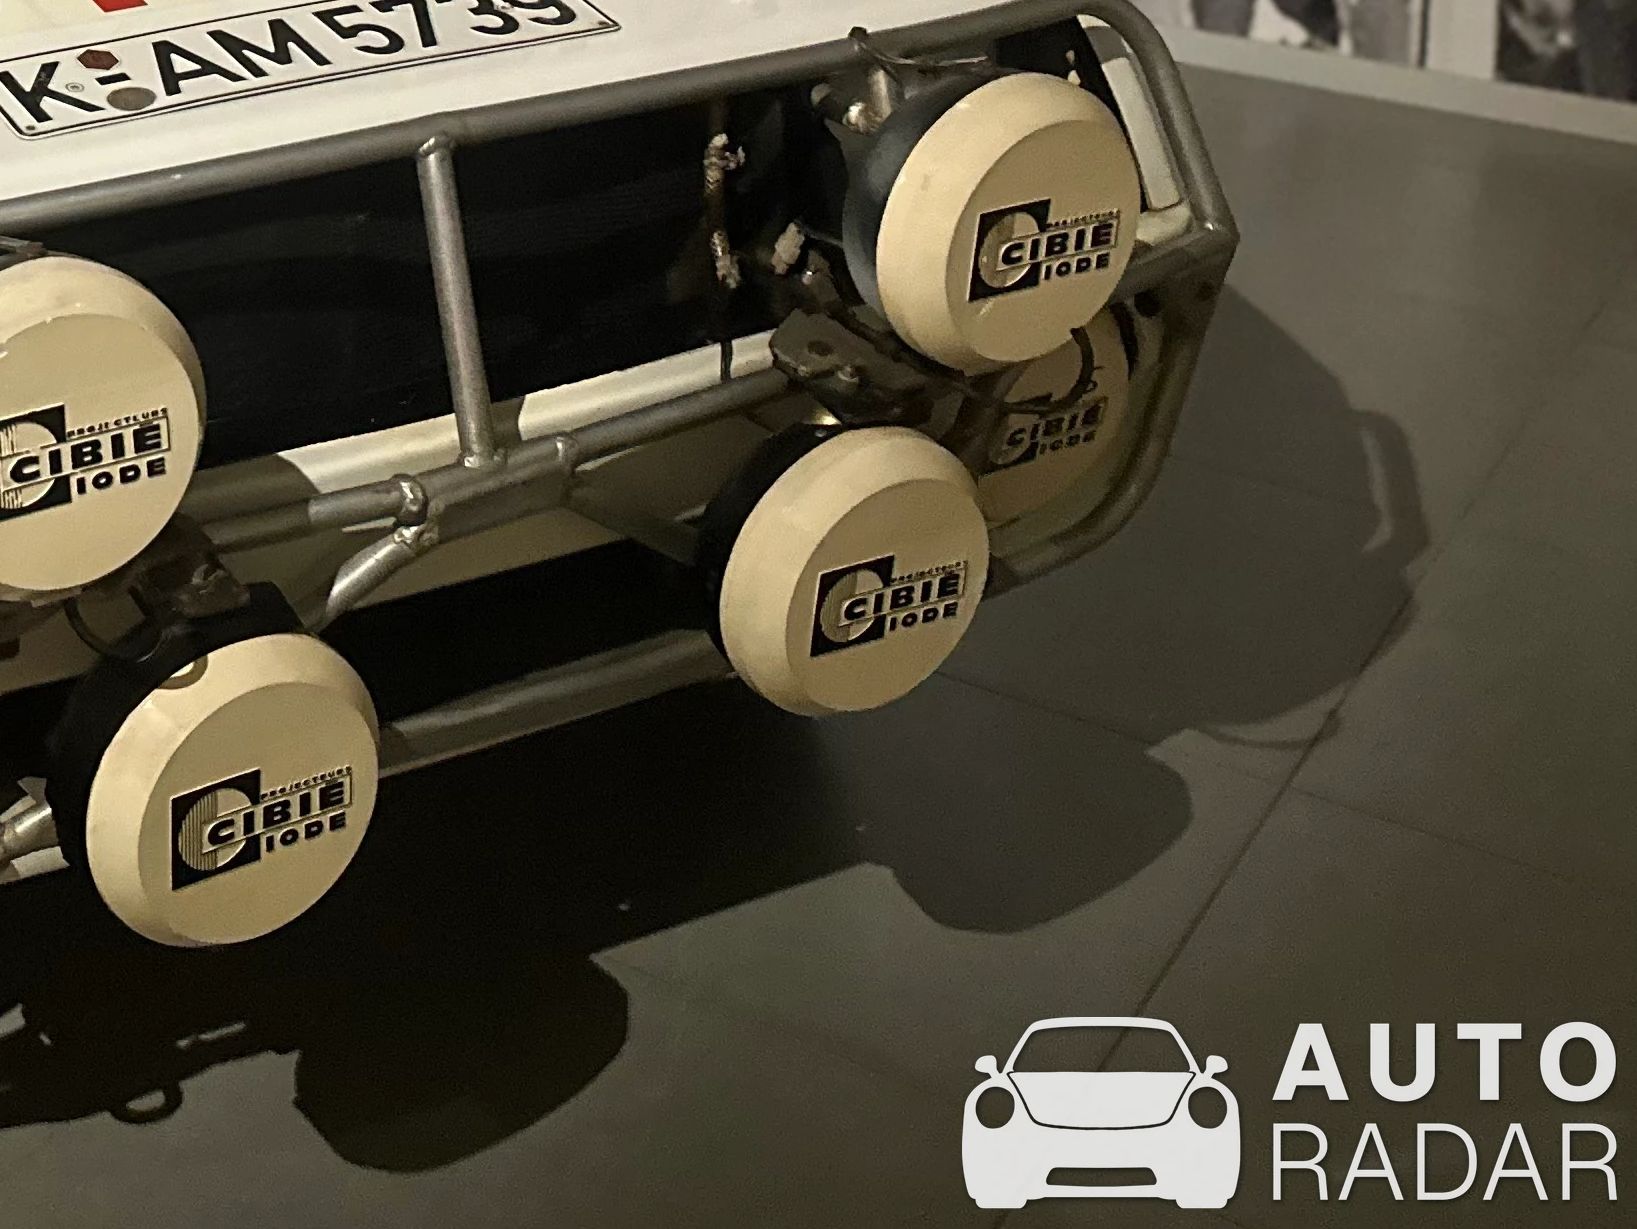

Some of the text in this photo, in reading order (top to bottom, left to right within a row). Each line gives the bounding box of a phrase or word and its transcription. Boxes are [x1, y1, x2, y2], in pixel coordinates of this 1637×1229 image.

[1044, 251, 1111, 281] IODE
[76, 456, 167, 495] IODE
[889, 601, 959, 632] IODE
[265, 810, 347, 853] IODE
